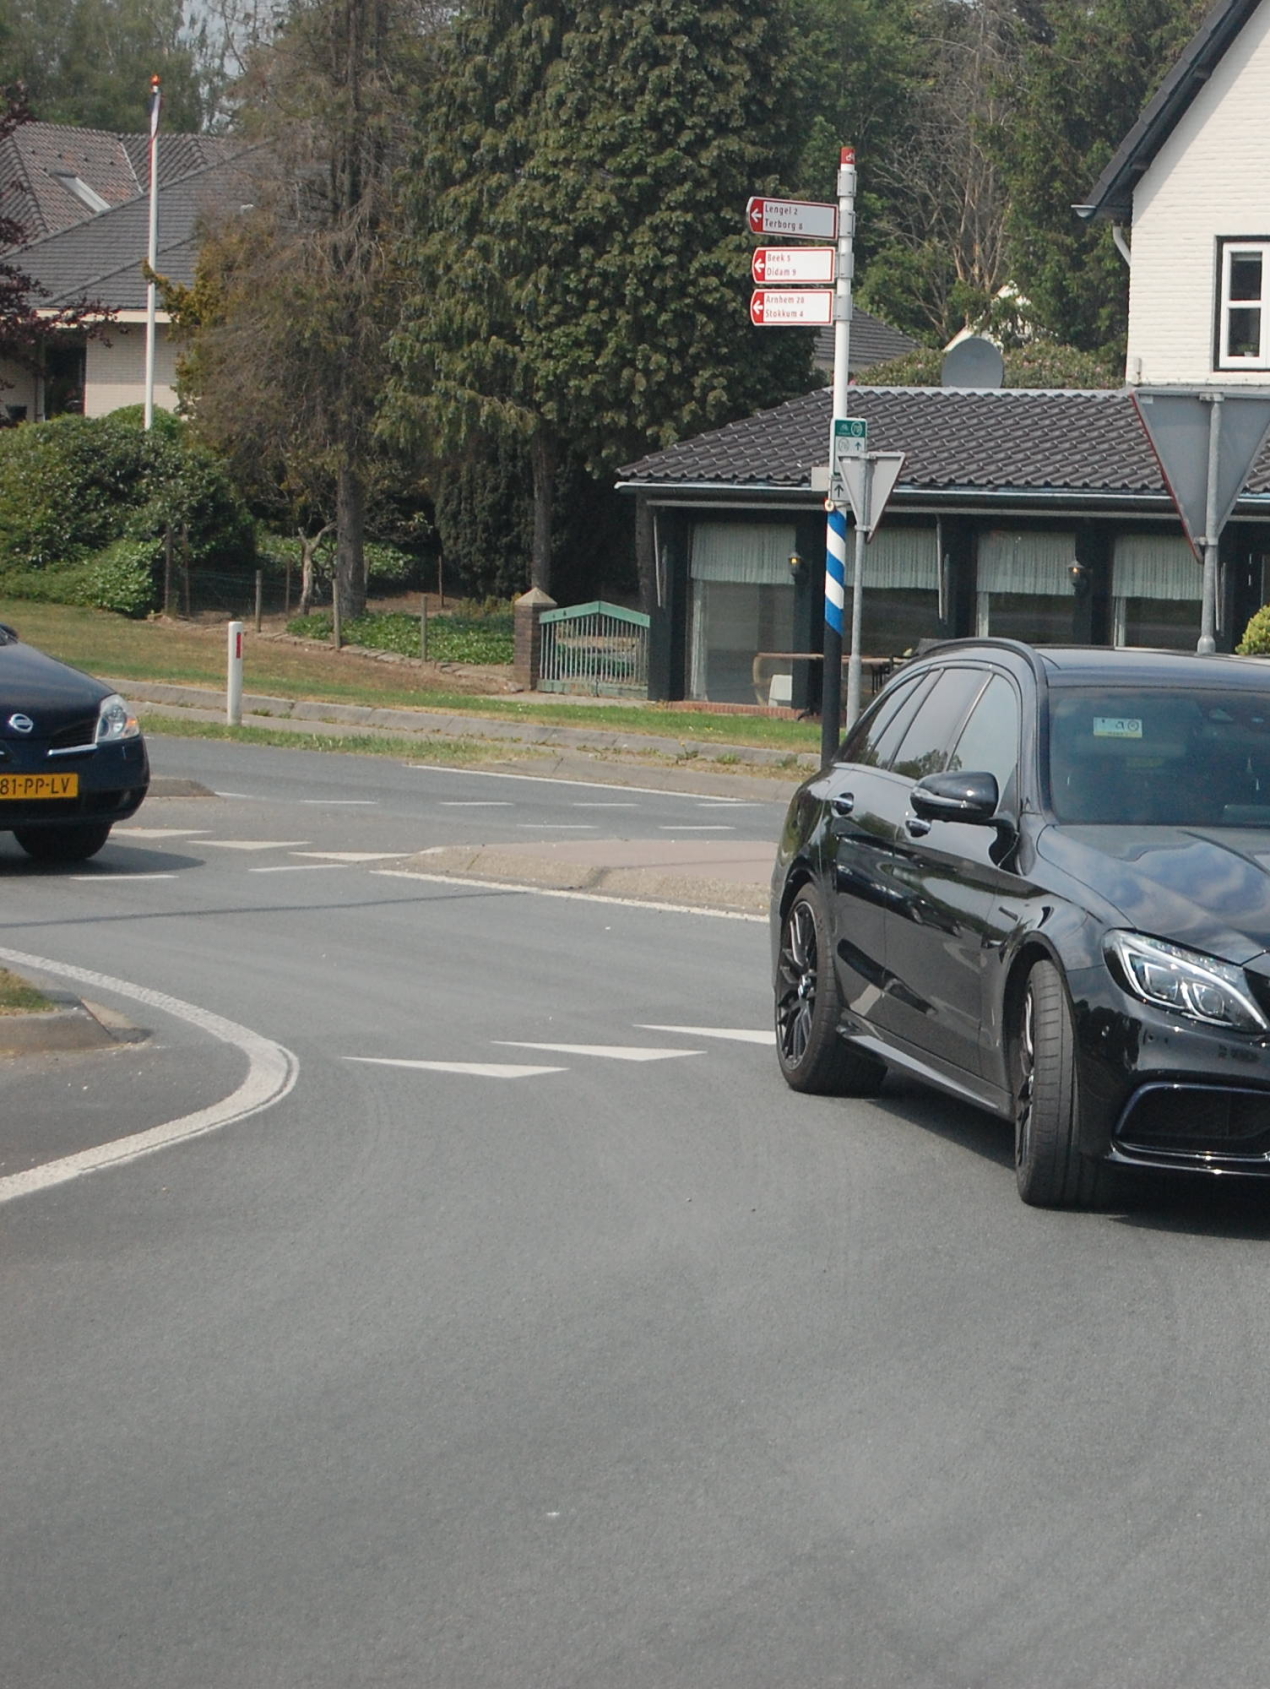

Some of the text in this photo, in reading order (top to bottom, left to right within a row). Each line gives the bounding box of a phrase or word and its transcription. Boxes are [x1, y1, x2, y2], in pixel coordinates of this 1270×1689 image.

[765, 204, 792, 216] Lengel
[765, 219, 796, 231] Terborg
[767, 253, 785, 262] Beek
[765, 295, 795, 304] Arnhem
[765, 309, 797, 317] Stokkum
[0, 778, 70, 795] 81-PP-LV
